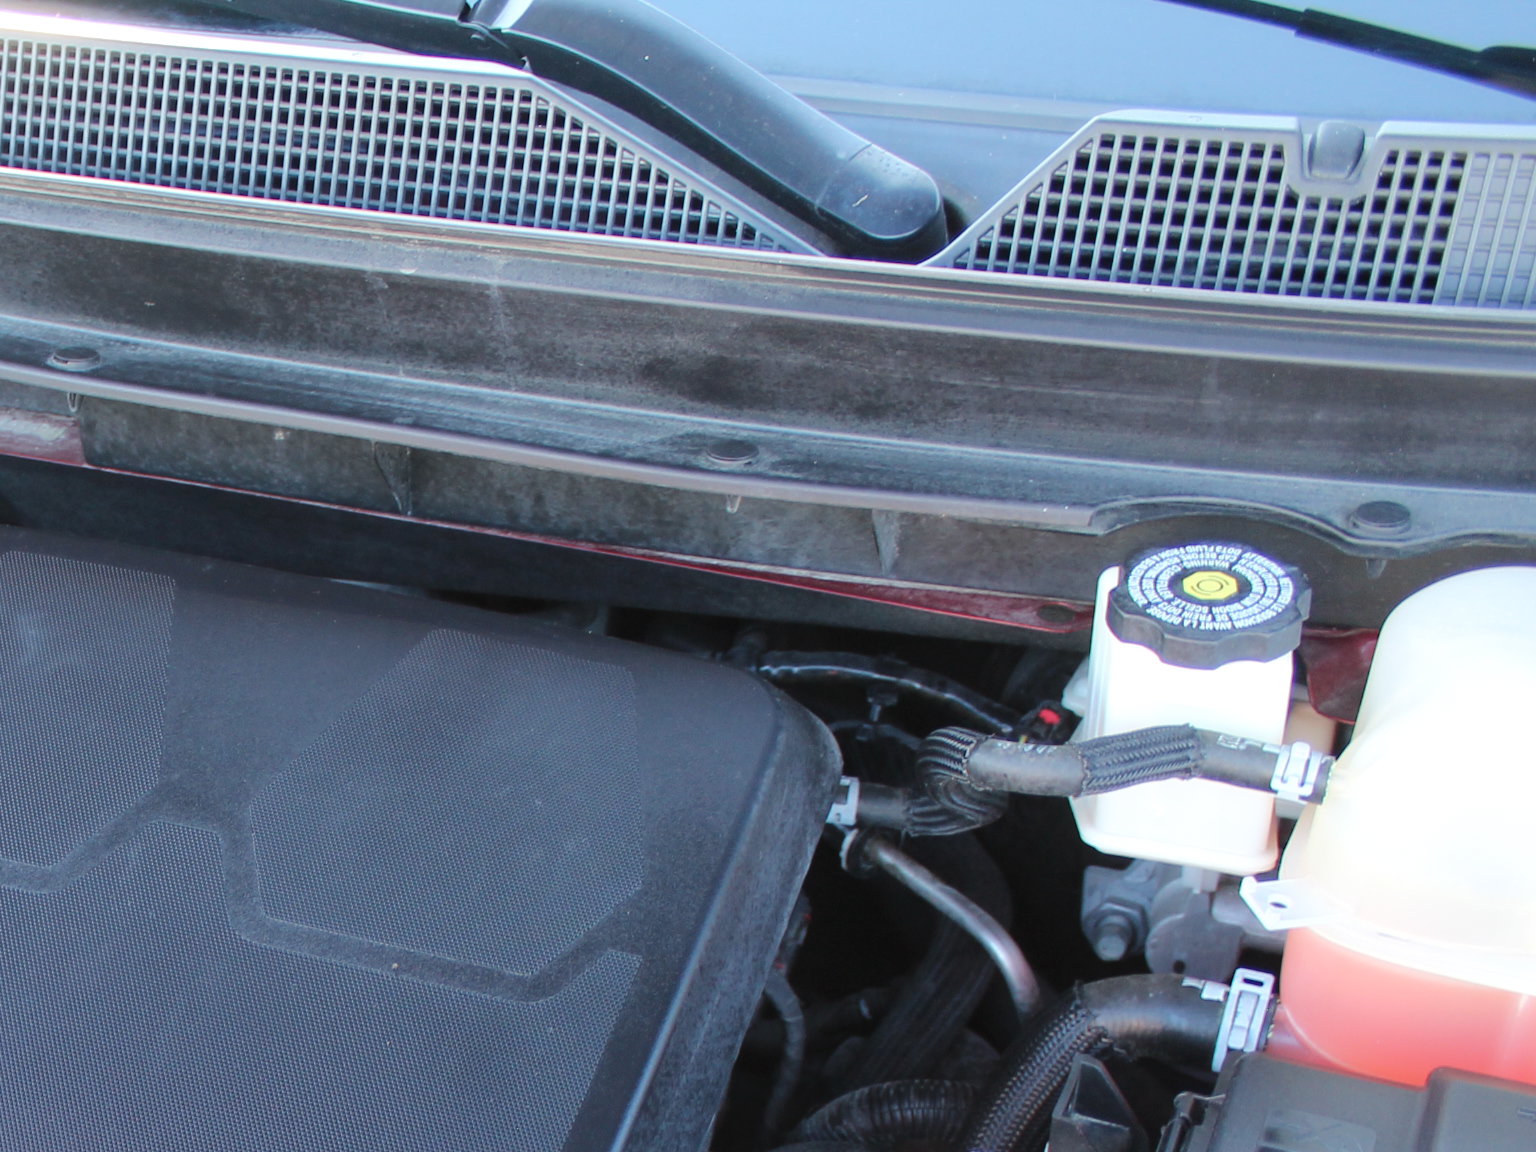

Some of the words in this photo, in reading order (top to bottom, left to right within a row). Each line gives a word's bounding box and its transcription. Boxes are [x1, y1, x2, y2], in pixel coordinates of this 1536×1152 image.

[1186, 545, 1214, 553] FLUID
[1218, 554, 1238, 562] CAP
[1182, 610, 1212, 621] FREIN
[1200, 622, 1232, 630] AVANT
